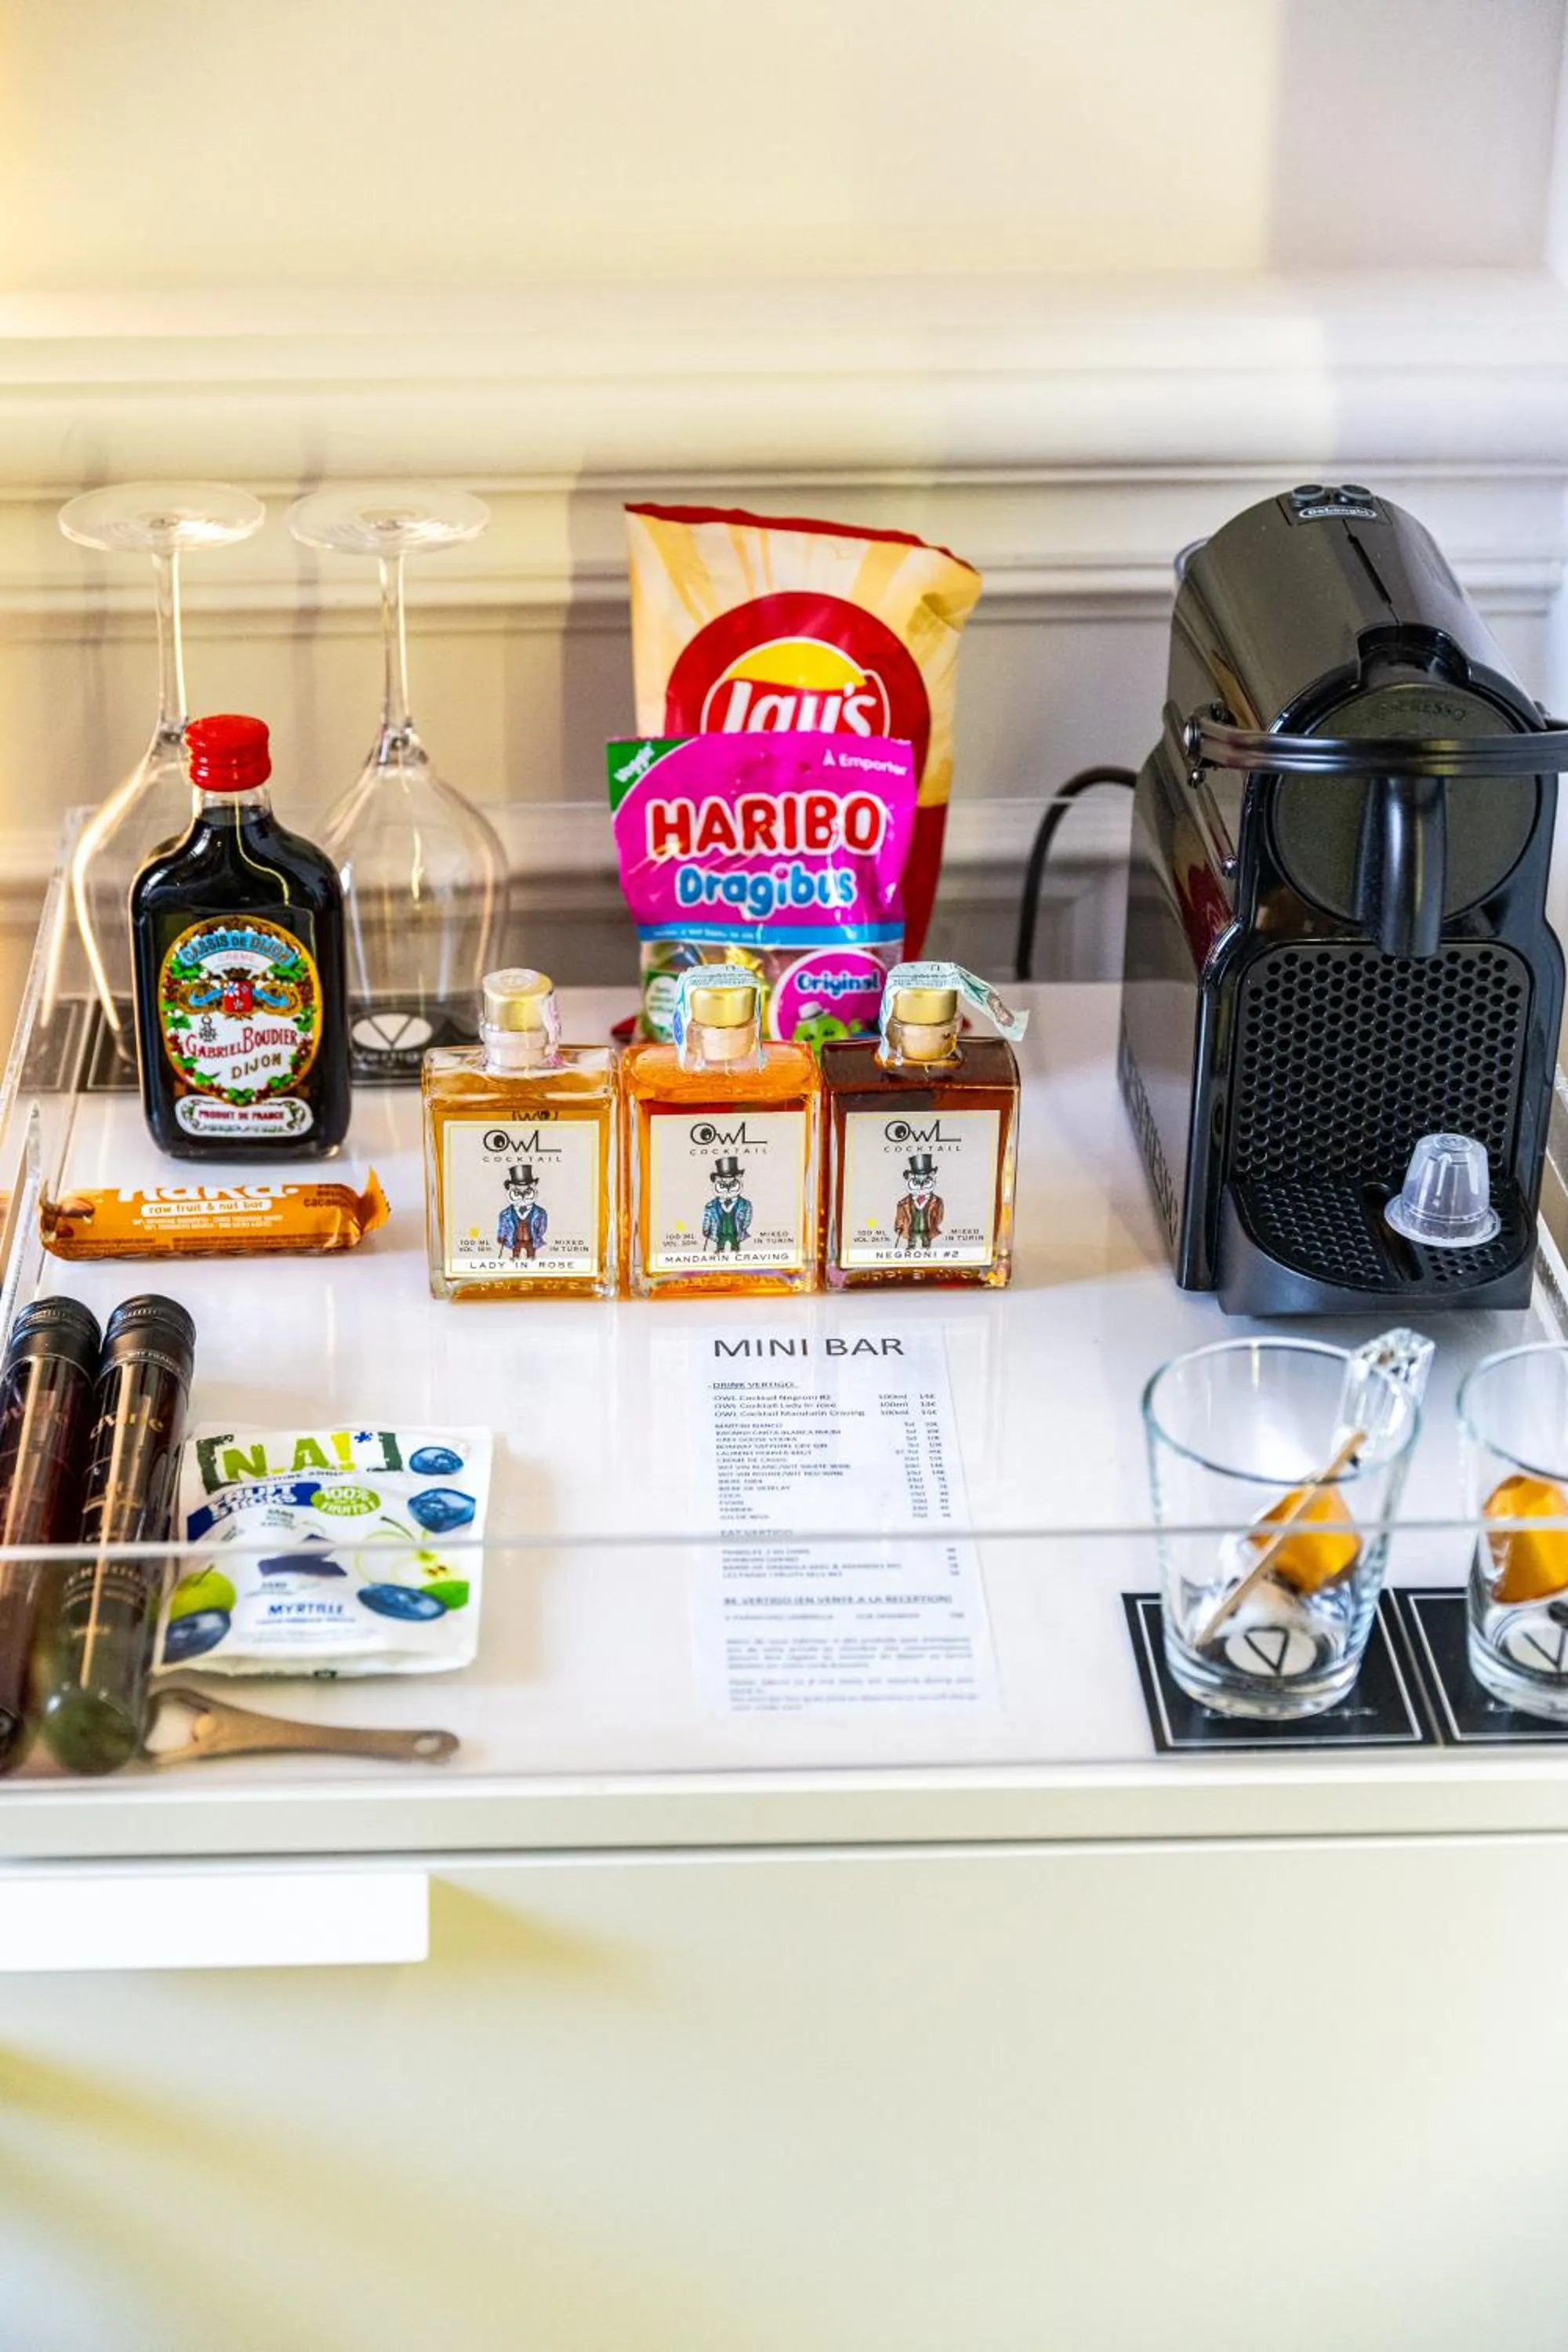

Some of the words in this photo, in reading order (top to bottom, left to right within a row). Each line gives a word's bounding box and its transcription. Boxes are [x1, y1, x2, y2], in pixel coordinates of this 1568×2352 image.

[839, 754, 908, 776] Emporter
[648, 792, 885, 859] HARIBO
[677, 865, 856, 918] Dragibus
[795, 971, 880, 998] Original
[185, 1034, 242, 1058] GABRIEL
[242, 1026, 298, 1054] BOUDIER
[230, 1053, 282, 1080] DIJON
[252, 1110, 285, 1120] FRANCE
[714, 1338, 808, 1357] MINI
[826, 1338, 905, 1356] BAR
